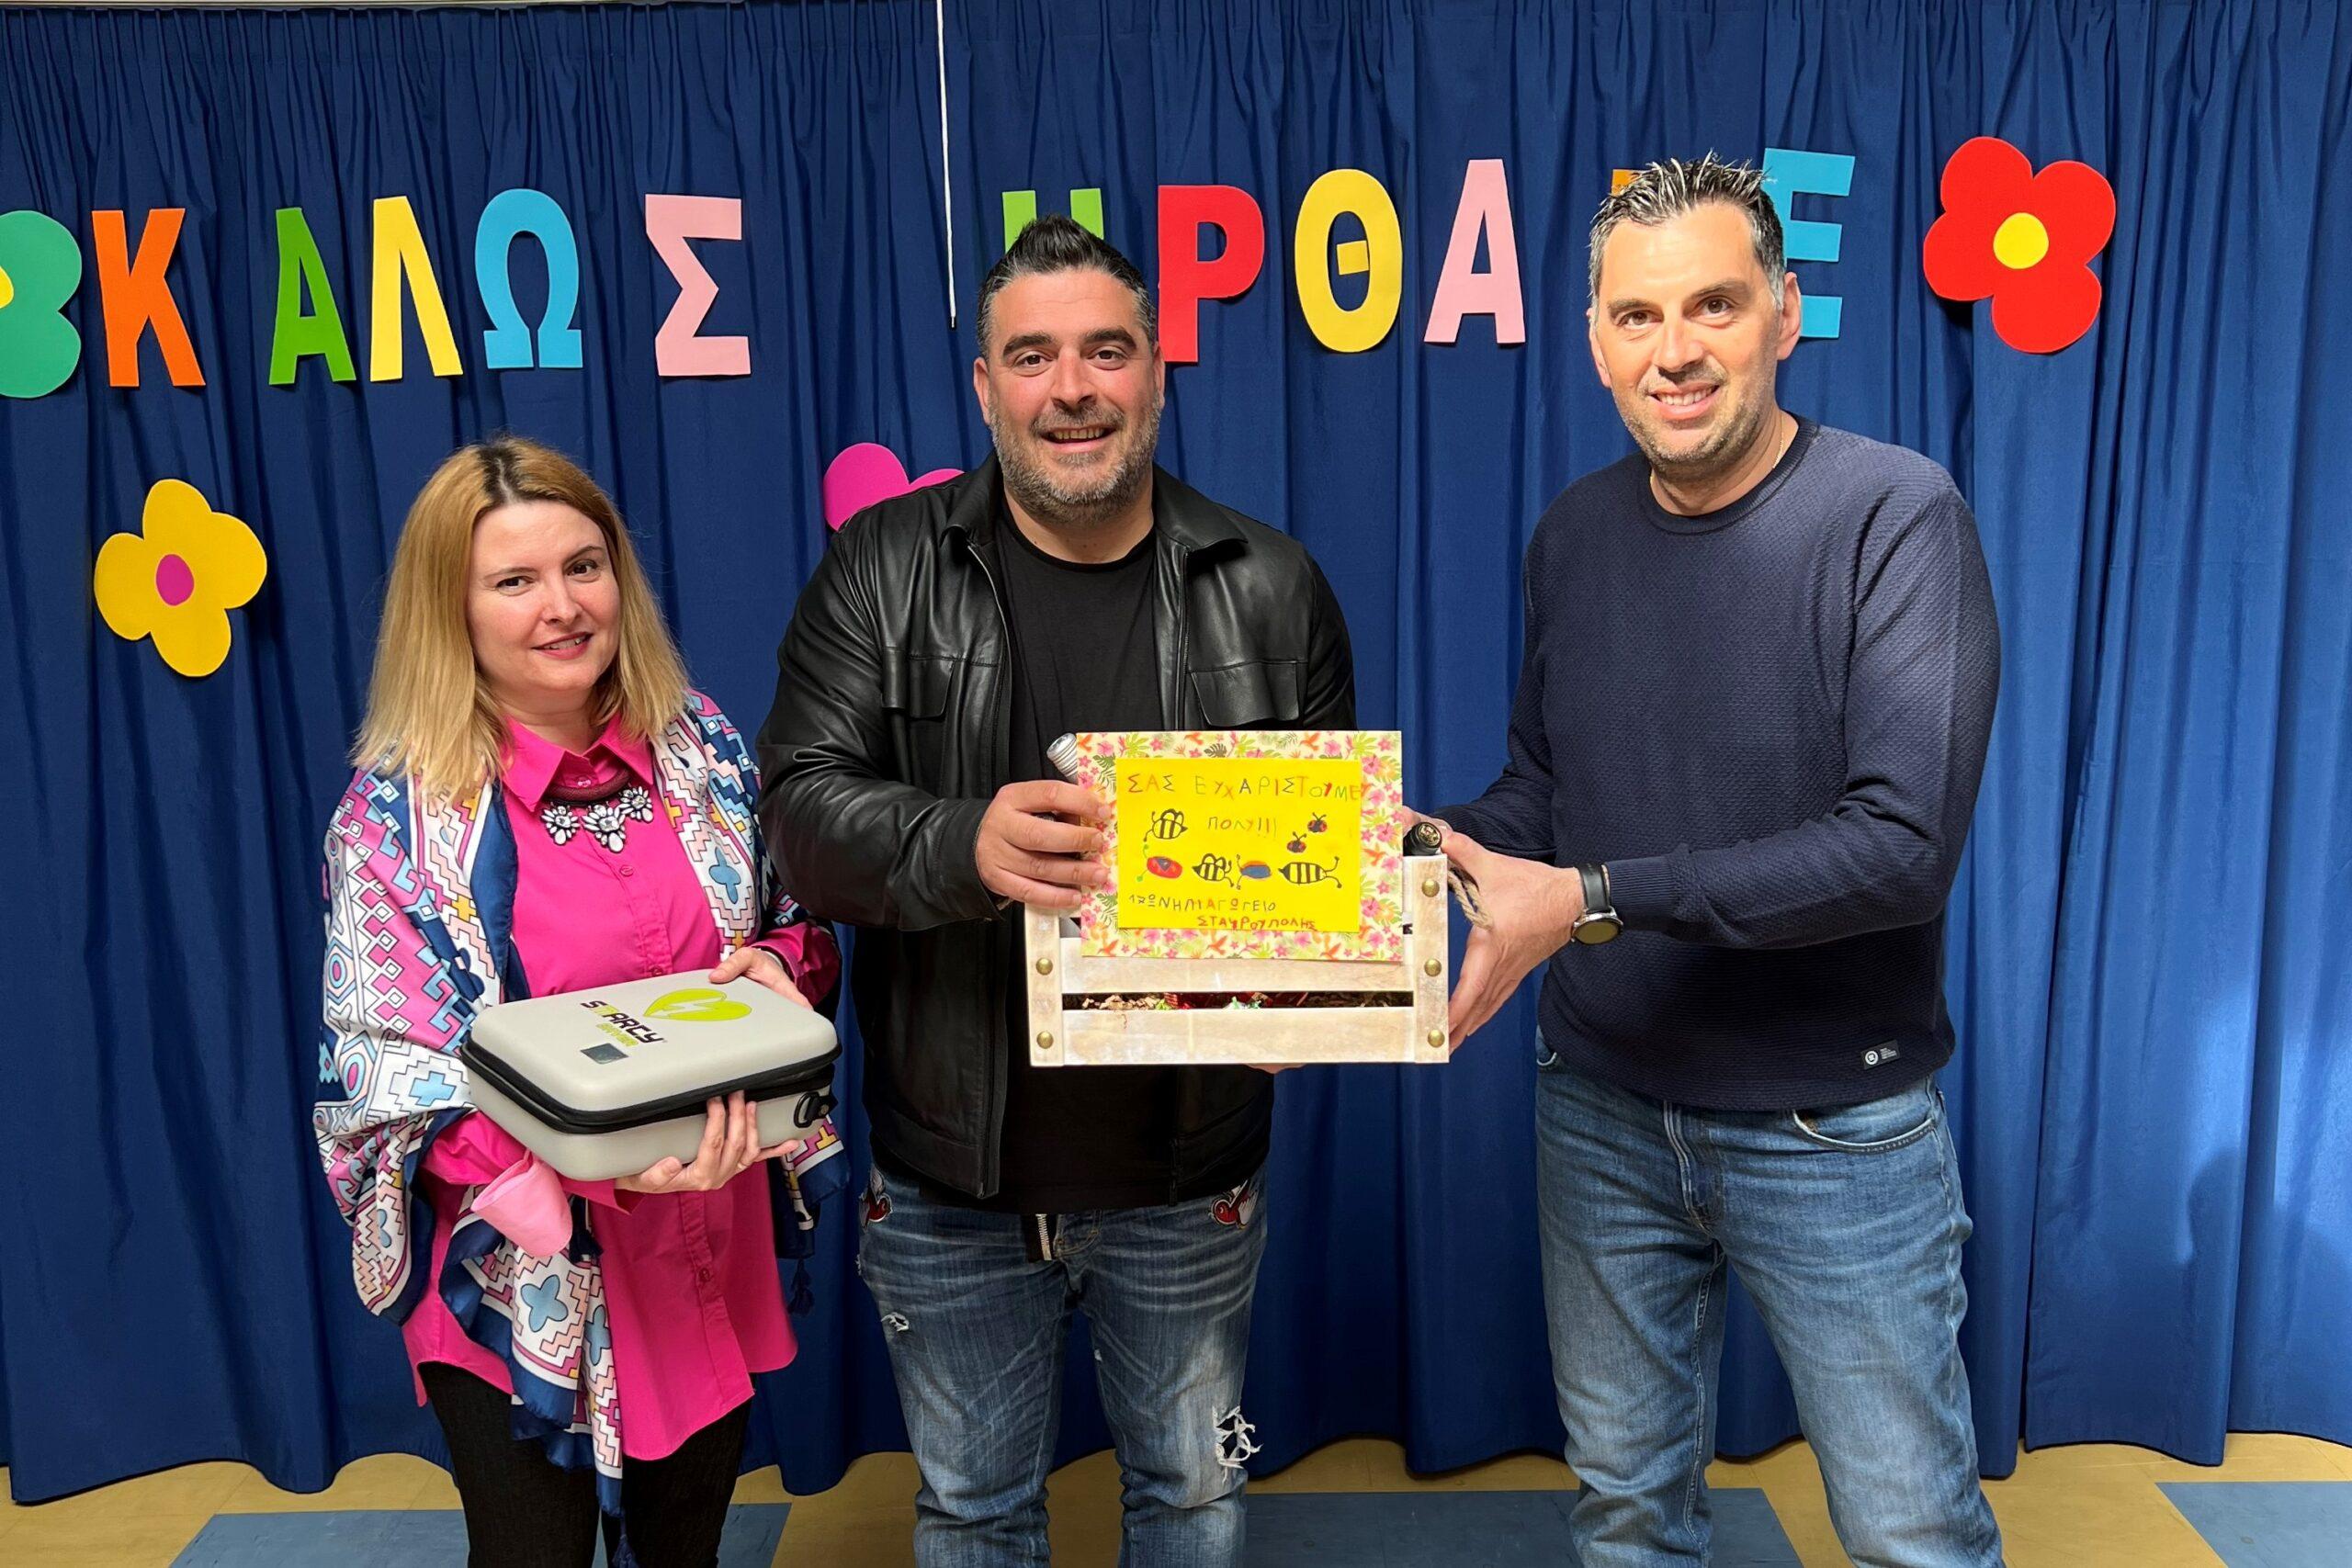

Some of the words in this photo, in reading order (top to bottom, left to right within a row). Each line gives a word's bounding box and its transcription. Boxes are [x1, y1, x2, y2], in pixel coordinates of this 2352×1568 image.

[91, 188, 752, 387] ΚΑΛΩΣ
[1001, 147, 1856, 365] ΡΘΑΕ
[1127, 773, 1175, 793] ΣΑΣ
